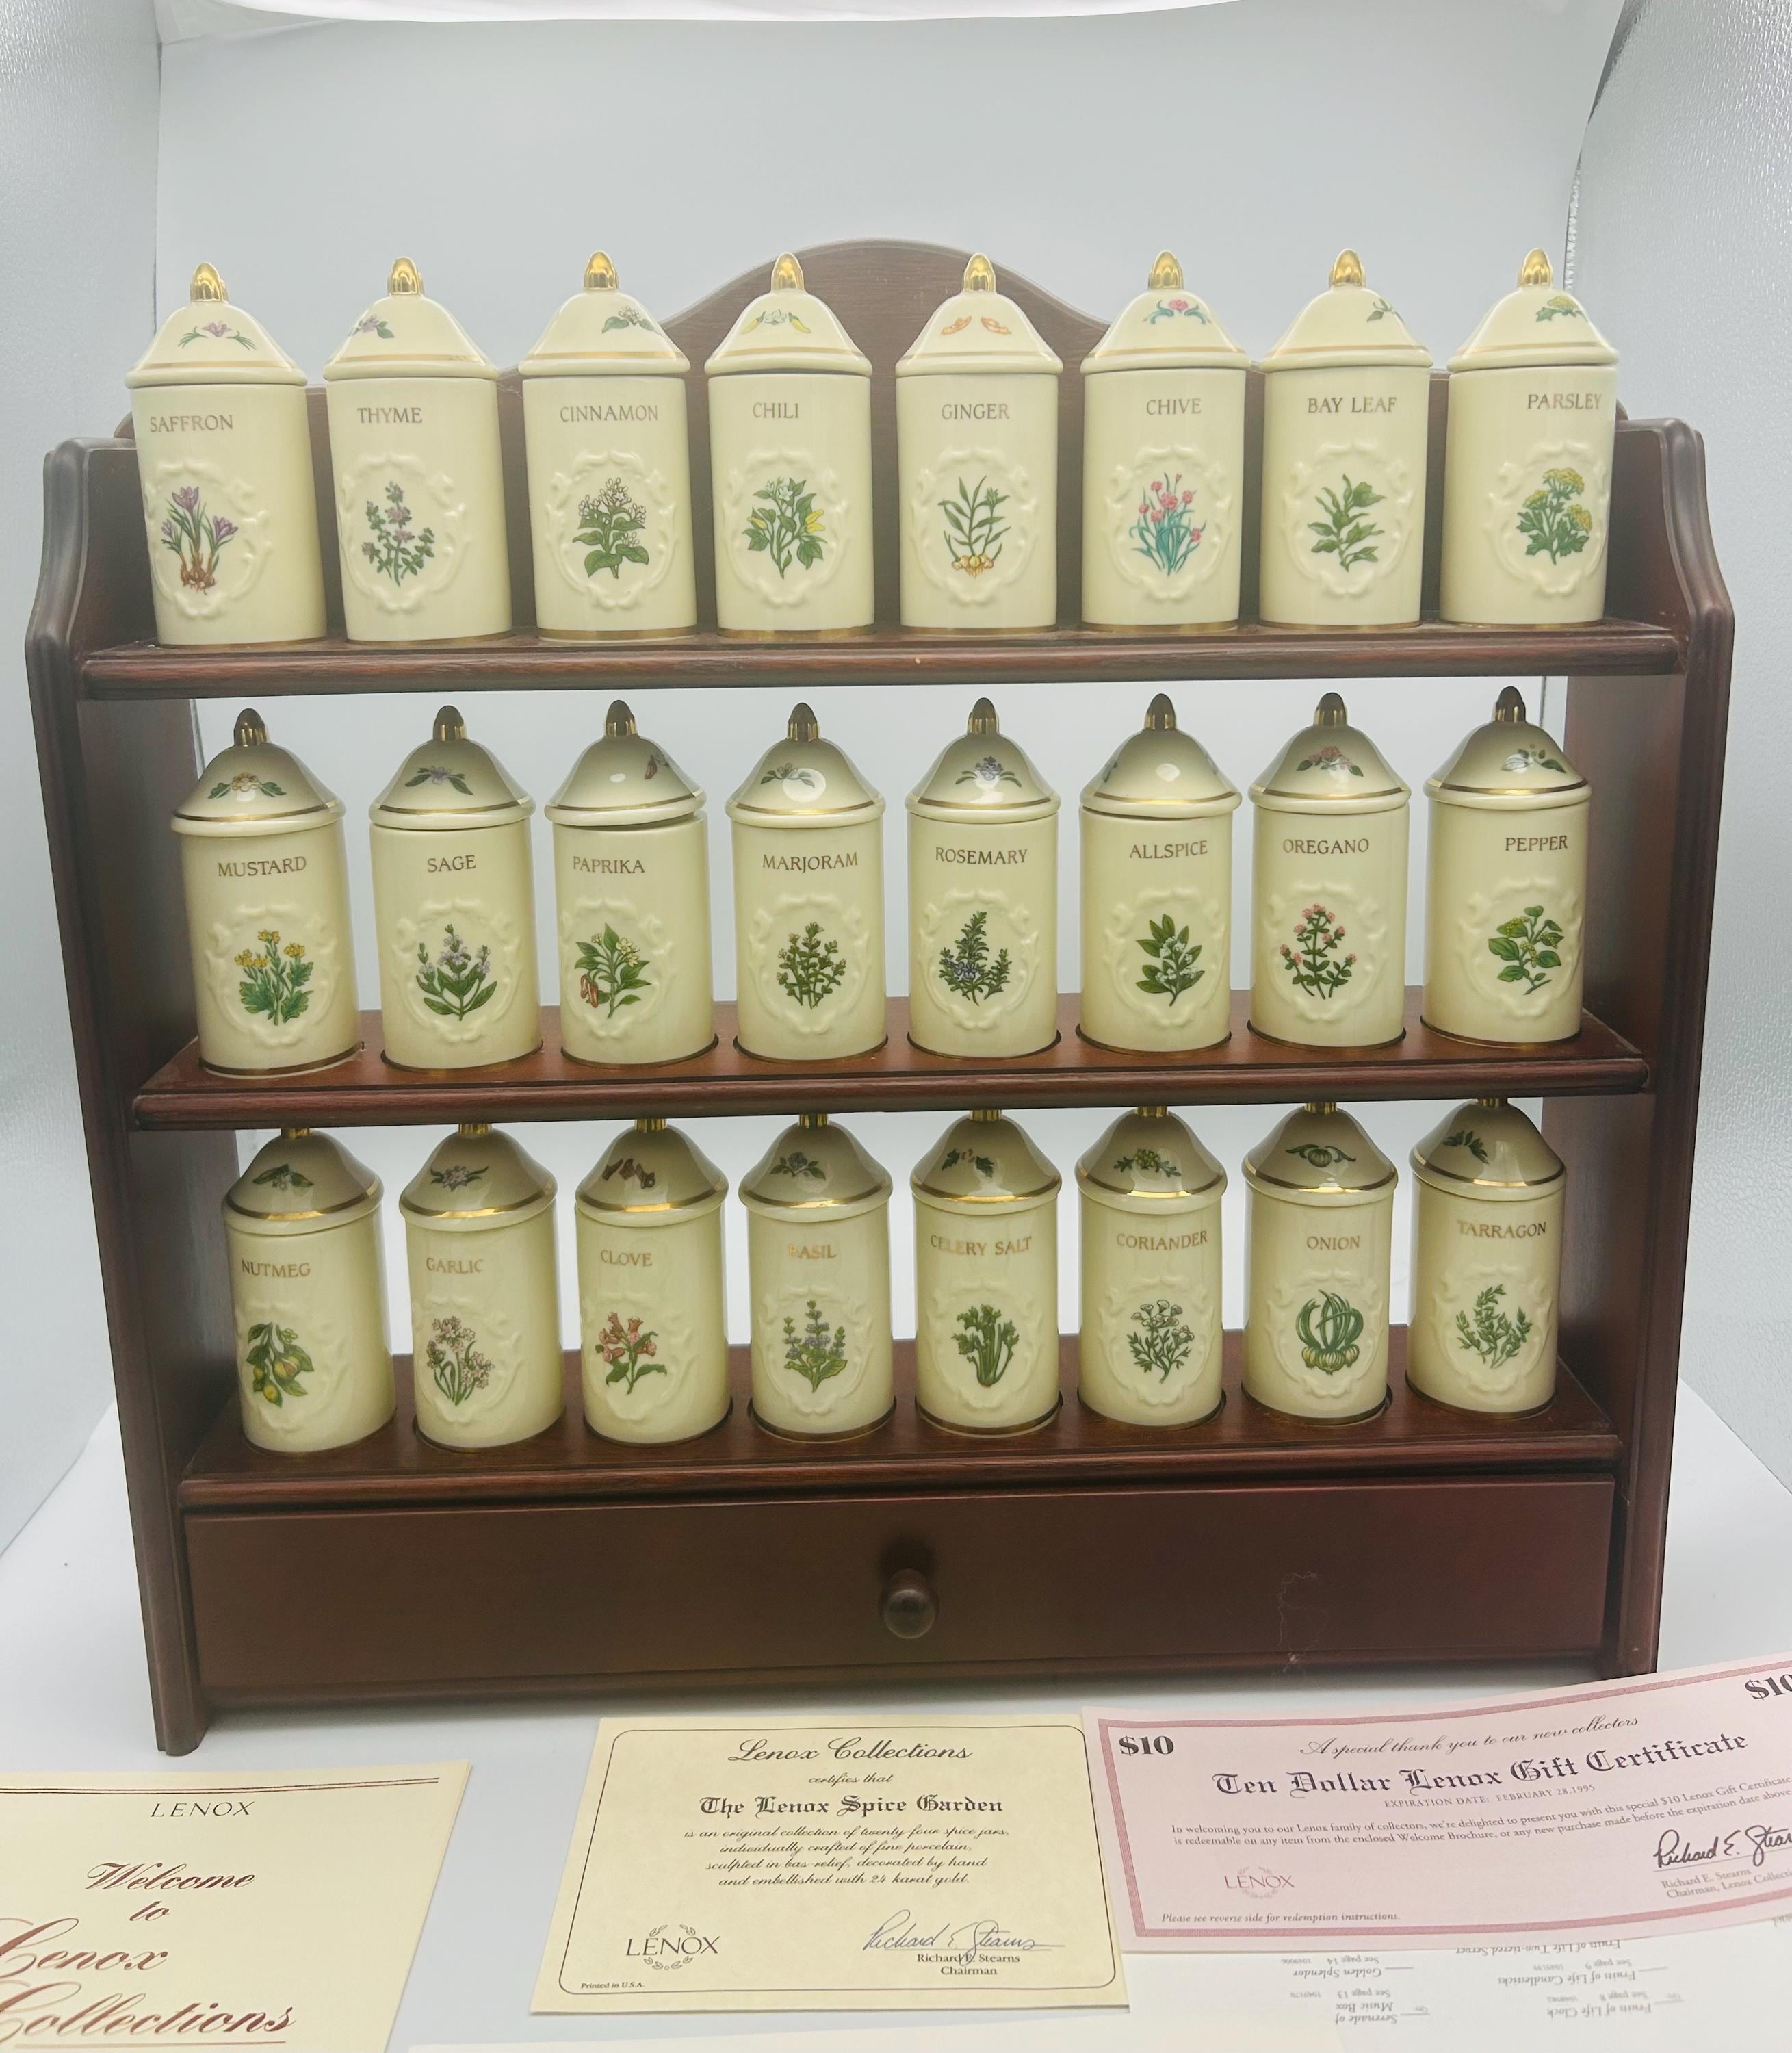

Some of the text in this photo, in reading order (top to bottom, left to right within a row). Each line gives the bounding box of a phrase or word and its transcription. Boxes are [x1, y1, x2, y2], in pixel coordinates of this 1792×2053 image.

[752, 403, 800, 419] CHILI
[1145, 398, 1202, 415] CHIVE
[1308, 396, 1397, 414] BAY LEAF
[1527, 393, 1602, 411] PARSLEY
[357, 406, 422, 424] THYME
[560, 404, 658, 423] CINNAMON
[941, 403, 1010, 422] GINGER
[149, 414, 233, 432] SAFFRON
[1128, 840, 1208, 860] ALLSPICE
[1282, 838, 1369, 856] OREGANO
[1505, 836, 1569, 852] PEPPER
[426, 854, 477, 874] SAGE
[572, 856, 645, 875] PAPRIKA
[762, 851, 859, 873] MARJORAM
[935, 847, 1028, 866] ROSEMARY
[218, 855, 307, 877] MUSTARD
[1458, 1220, 1546, 1241] TARRAGON
[930, 1235, 1032, 1256] CELERY SALT
[1116, 1230, 1208, 1251] CORIANDER
[1306, 1235, 1360, 1251] ONION
[599, 1250, 653, 1268] CLOVE
[788, 1243, 837, 1260] BASIL
[241, 1258, 311, 1279] NUTMEG
[426, 1256, 484, 1276] GARLIC
[1300, 1714, 1639, 1759] A special thank you to our new collectors
[727, 1737, 973, 1761] Lenox Collections
[1118, 1735, 1174, 1757] $10
[1212, 1733, 1748, 1799] Ten Dollar Lenox Gift Certificate
[809, 1772, 894, 1787] certifies that
[699, 1794, 1002, 1819] The Lenox Spice Garden
[1171, 1824, 1182, 1833] In
[1186, 1824, 1241, 1835] welcoming
[1242, 1826, 1261, 1835] you
[1297, 1824, 1328, 1833] Lenox
[1330, 1822, 1361, 1833] family
[1364, 1822, 1375, 1831] of
[1377, 1821, 1428, 1831] collectors,
[1458, 1818, 1504, 1829] delighted
[1521, 1814, 1556, 1826] present
[1559, 1811, 1578, 1821] you
[1579, 1807, 1603, 1816] with
[1605, 1804, 1624, 1813] this
[1626, 1798, 1659, 1812] special
[1660, 1795, 1680, 1805] $10
[1682, 1791, 1715, 1802] Lenox
[1716, 1785, 1737, 1796] Gift
[1739, 1777, 1791, 1791] Certificate
[1384, 1798, 1453, 1808] EXPIRATION
[1456, 1796, 1490, 1805] DATE:
[1496, 1789, 1553, 1802] FEBRUARY
[151, 1801, 255, 1818] LENOX
[1174, 1837, 1182, 1845] is
[1185, 1836, 1241, 1845] redeemable
[1260, 1837, 1277, 1846] any
[1281, 1836, 1303, 1844] item
[1306, 1835, 1331, 1844] from
[1334, 1835, 1350, 1843] the
[1353, 1833, 1395, 1842] enclosed
[1397, 1832, 1445, 1841] Welcome
[1448, 1830, 1498, 1840] Brochure,
[1514, 1829, 1531, 1837] any
[1558, 1822, 1602, 1834] purchase
[1605, 1818, 1631, 1826] made
[1633, 1811, 1665, 1822] before
[1668, 1807, 1684, 1817] the
[1687, 1799, 1737, 1814] expiration
[1739, 1795, 1761, 1805] date
[1763, 1790, 1791, 1800] above
[723, 1826, 780, 1842] original
[781, 1826, 838, 1837] collection
[844, 1825, 861, 1839] of
[944, 1826, 976, 1838] spice
[974, 1828, 1009, 1839] jars,
[720, 1840, 972, 1857] individually crafted of fine porcelain,
[706, 1859, 764, 1872] sculpted
[857, 1857, 925, 1867] decorated
[926, 1856, 944, 1872] by
[948, 1856, 988, 1867] hand
[85, 1862, 255, 1890] Welcome
[718, 1876, 751, 1885] and
[753, 1873, 833, 1885] embellished
[835, 1872, 866, 1883] with
[892, 1872, 933, 1883] karat
[933, 1872, 968, 1888] gold.
[1223, 1875, 1295, 1889] LENOX
[129, 1900, 170, 1922] to
[1162, 1913, 1191, 1922] Please
[1245, 1913, 1264, 1922] side
[1265, 1913, 1280, 1924] for
[1283, 1913, 1338, 1924] redemption
[1341, 1912, 1401, 1921] instructions.
[626, 1936, 720, 1956] LENOX
[916, 1952, 1020, 1963] Richard Stearns
[940, 1966, 998, 1975] Chairman
[1293, 1966, 1381, 1979] Golden Splendor
[1498, 1970, 1636, 1987] Fruits of Life Candlesticks
[1336, 2002, 1393, 2012] Music Box
[1334, 2013, 1397, 2025] Serenade of
